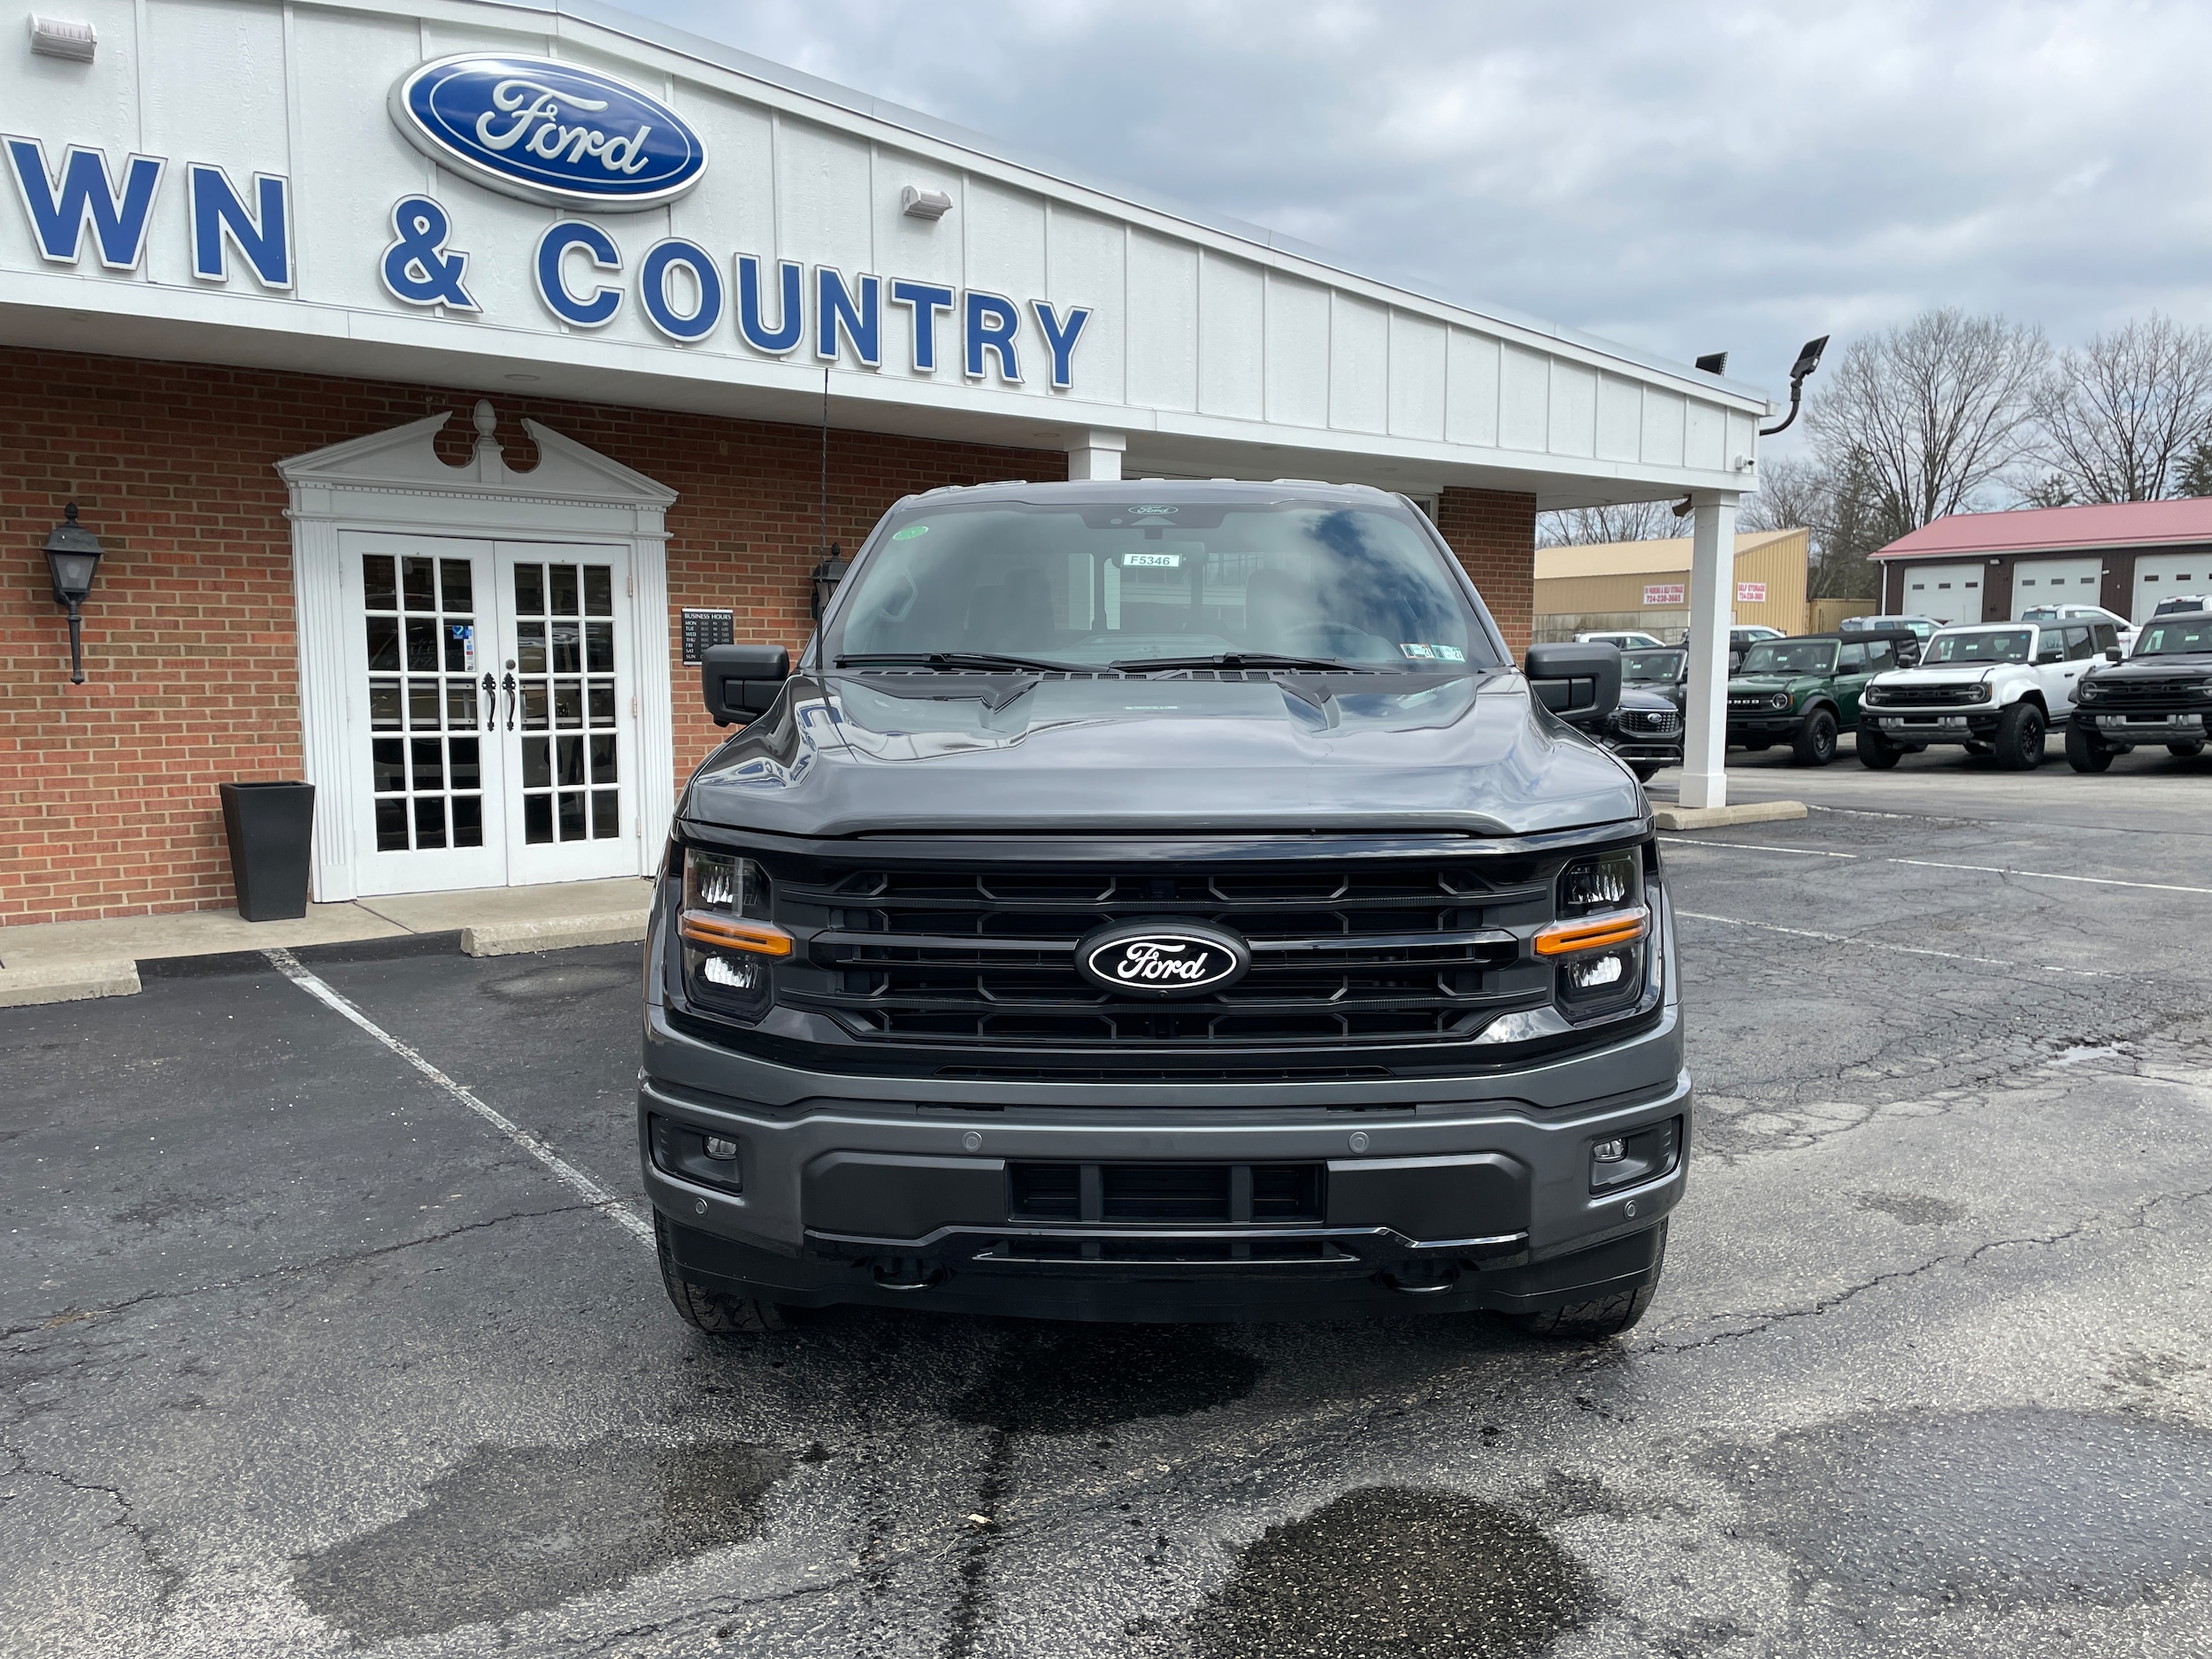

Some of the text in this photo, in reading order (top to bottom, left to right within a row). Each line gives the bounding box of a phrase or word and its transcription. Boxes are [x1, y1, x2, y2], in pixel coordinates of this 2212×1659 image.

[475, 79, 651, 175] Ford
[380, 193, 483, 313] &
[534, 219, 1093, 389] COUNTRY
[1131, 556, 1171, 565] F5346
[1118, 942, 1209, 979] Ford
